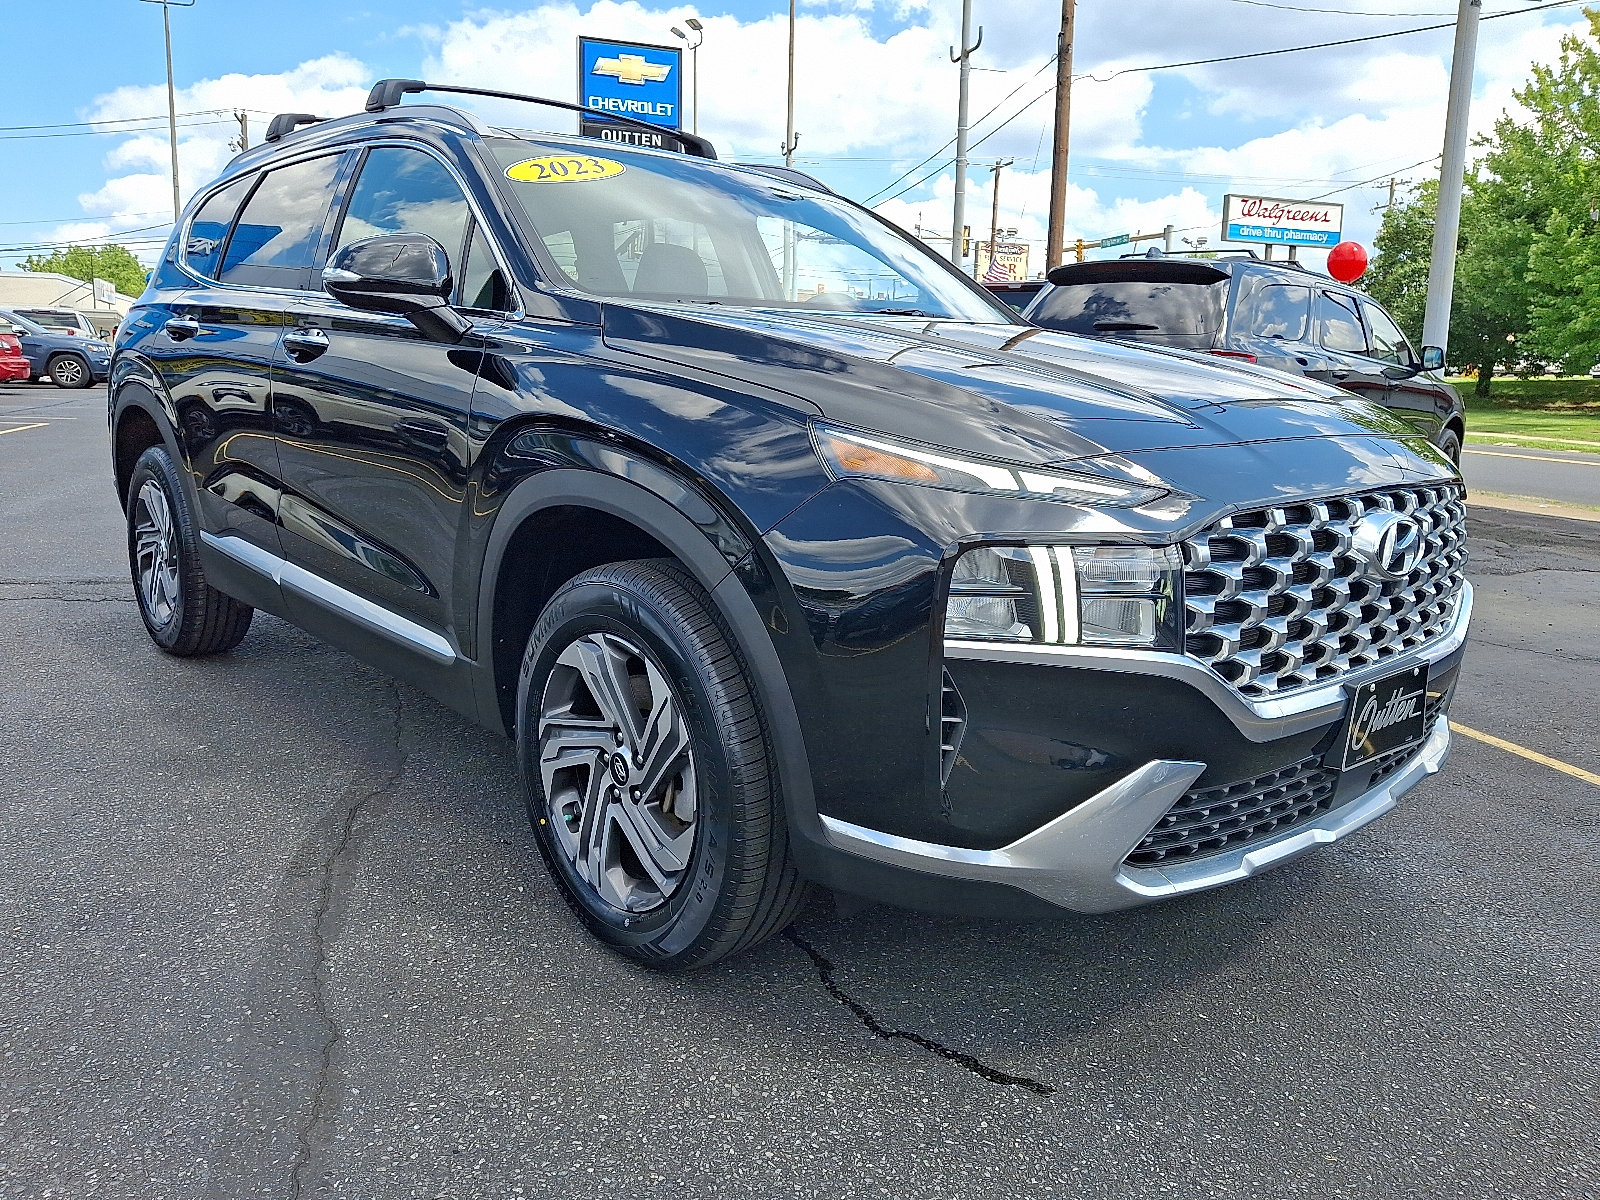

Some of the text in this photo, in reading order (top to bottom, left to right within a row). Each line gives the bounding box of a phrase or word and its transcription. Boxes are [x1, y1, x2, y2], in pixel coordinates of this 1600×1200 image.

[588, 95, 674, 117] CHEVROLET
[601, 129, 662, 147] OUTTEN
[529, 158, 606, 180] 2023
[1240, 198, 1332, 226] Walgreens
[1240, 225, 1329, 243] drive thru pharmacy
[999, 255, 1022, 263] SERVICE
[1351, 686, 1424, 751] Outten
